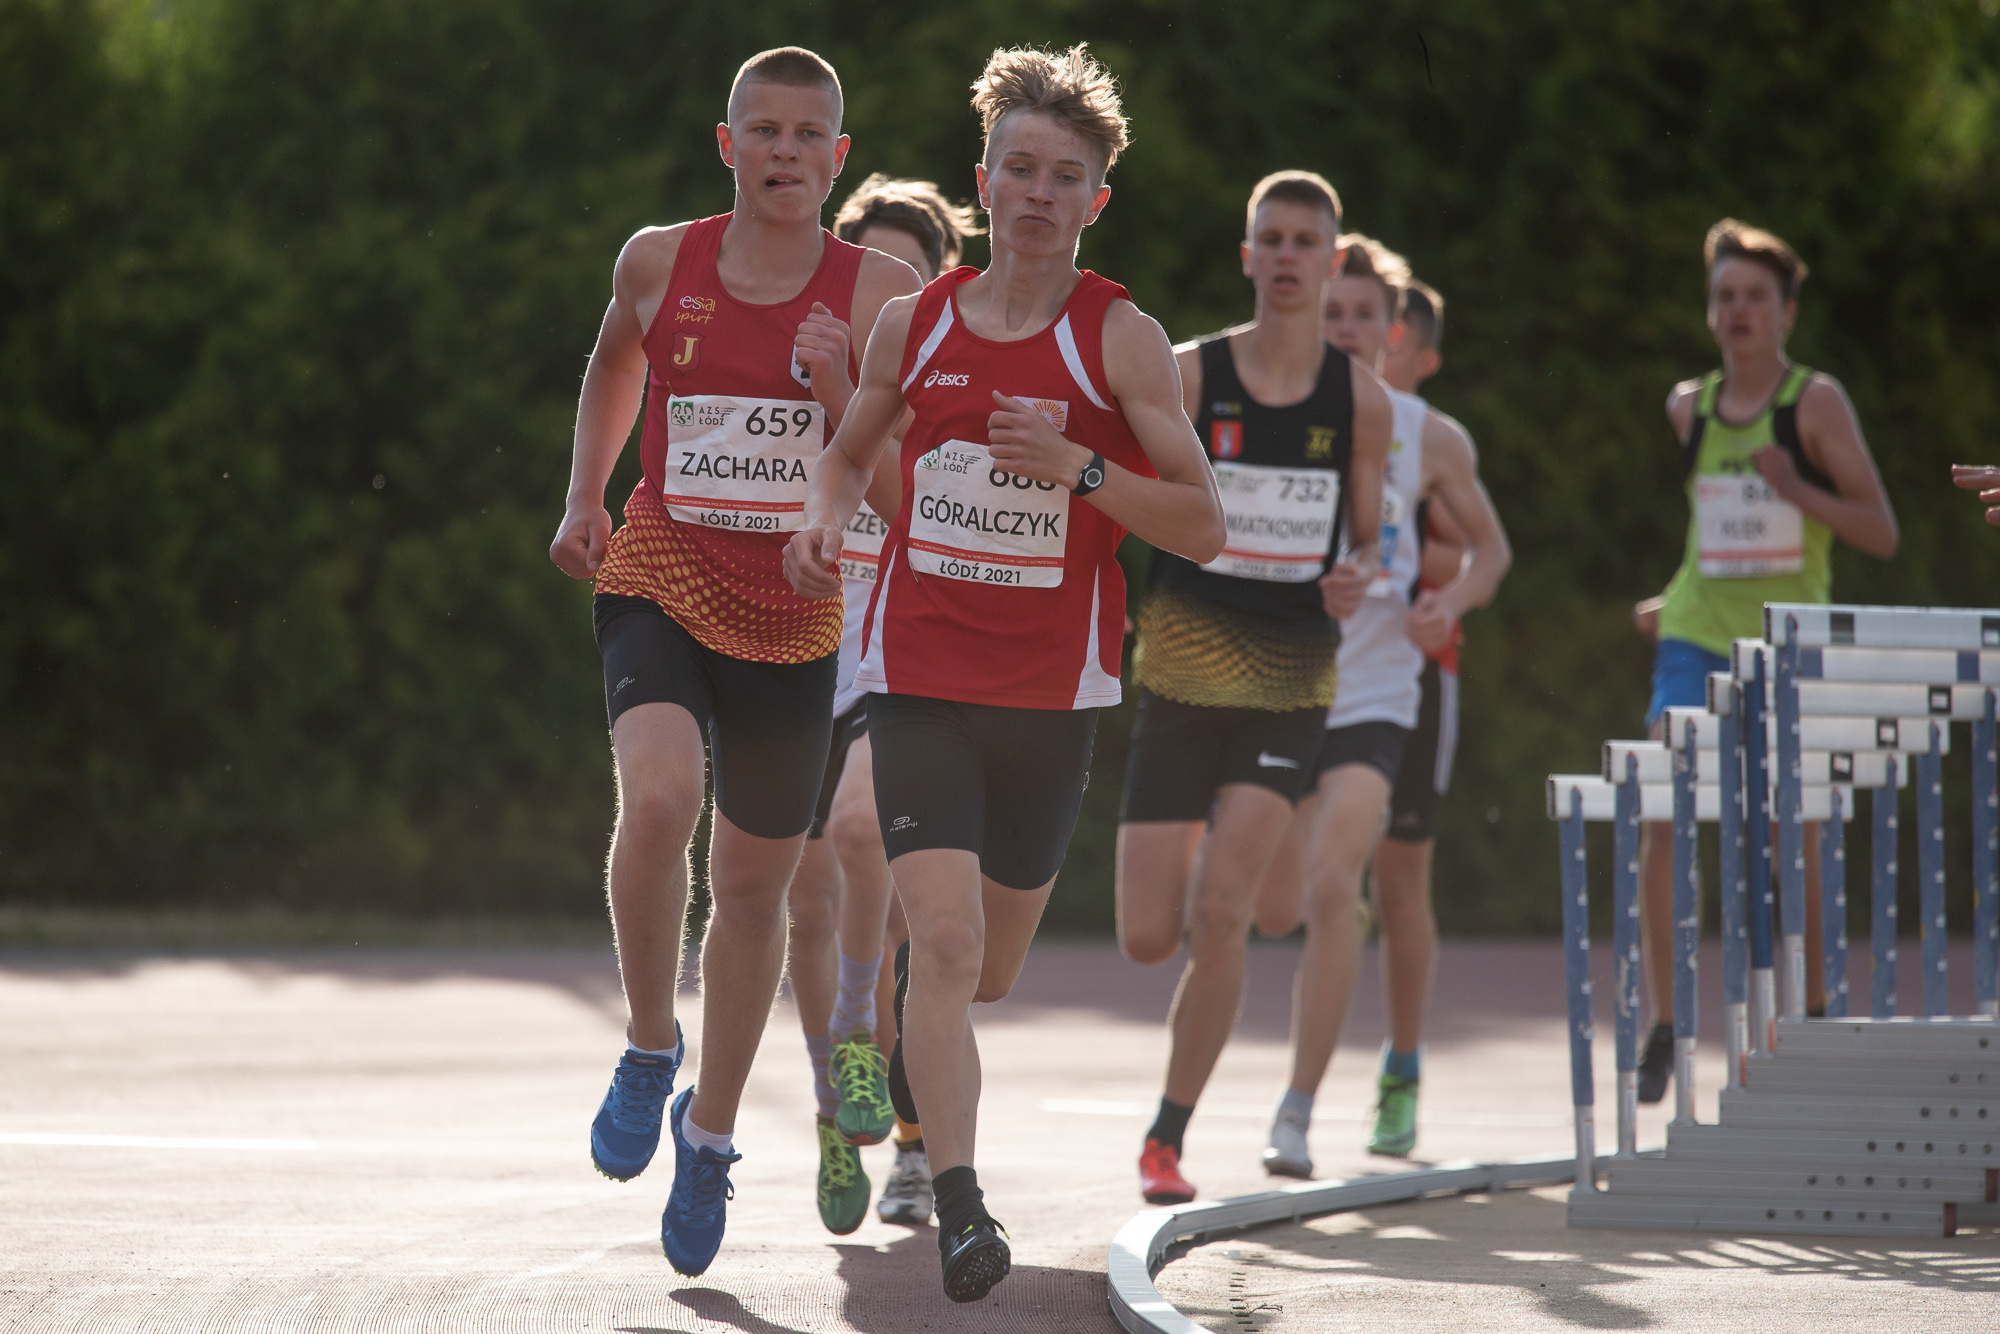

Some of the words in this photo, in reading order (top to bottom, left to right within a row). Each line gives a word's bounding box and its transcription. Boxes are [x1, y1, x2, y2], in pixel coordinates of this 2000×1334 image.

[673, 336, 699, 365] J
[937, 374, 970, 387] asics
[745, 406, 812, 438] 659
[679, 451, 808, 483] ZACHARA
[1278, 475, 1329, 502] 732
[700, 510, 740, 528] ŁÓDŹ
[744, 515, 780, 530] 2021
[919, 494, 1061, 538] GÓRALCZYK
[939, 558, 980, 580] ŁÓDŹ
[983, 567, 1021, 584] 2021
